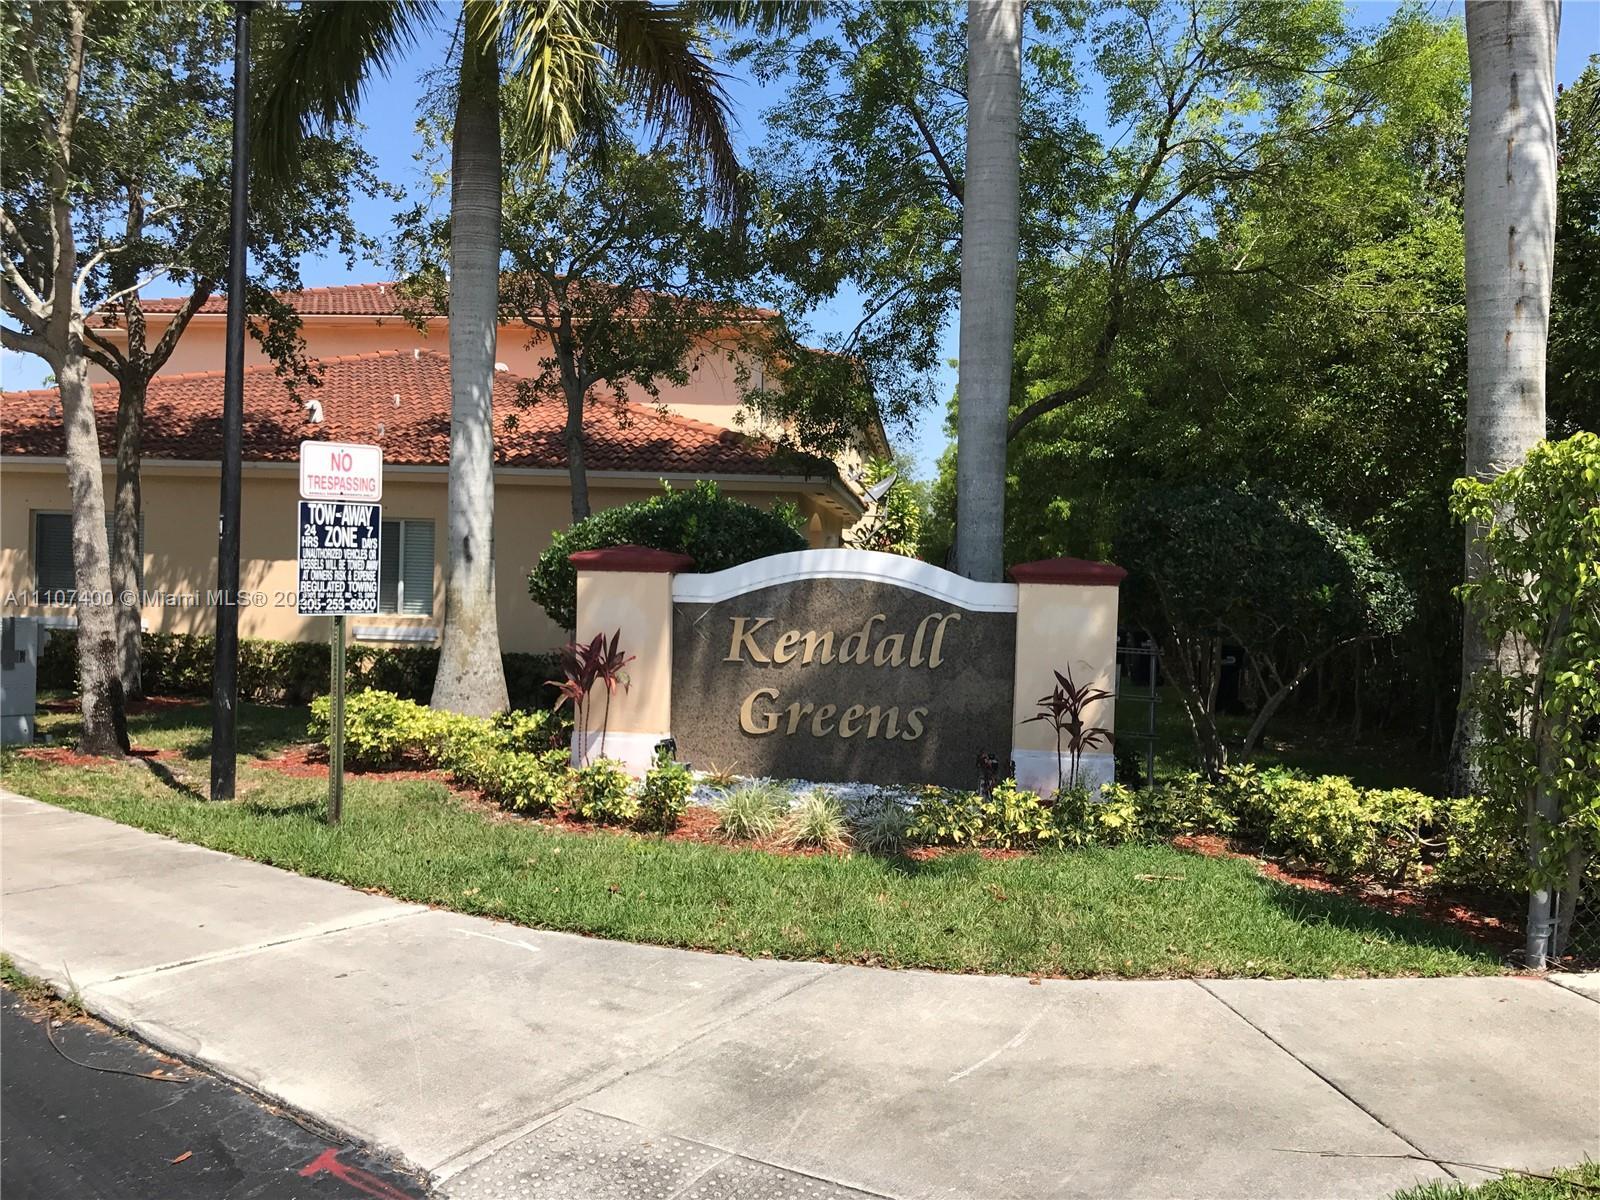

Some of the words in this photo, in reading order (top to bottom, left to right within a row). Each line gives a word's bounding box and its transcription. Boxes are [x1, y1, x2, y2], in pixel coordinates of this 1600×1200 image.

[331, 452, 353, 472] NO
[307, 474, 376, 492] TRESPASSING
[307, 503, 373, 526] TOW-AWAY
[304, 524, 317, 536] 24
[366, 527, 374, 538] 7
[301, 536, 319, 548] HRS
[324, 526, 358, 548] ZONE
[361, 538, 378, 549] DAYS
[302, 548, 343, 559] UNAUTHORIZED
[343, 549, 368, 560] VEHICLES
[368, 550, 377, 560] OR
[300, 559, 325, 570] VESSELS
[325, 559, 338, 570] WILL
[338, 560, 346, 570] BE
[347, 560, 365, 571] TOWED
[302, 569, 310, 581] AT
[334, 571, 347, 581] RISK
[353, 571, 377, 581] EXPENSE
[300, 580, 346, 593] REGULATED
[347, 581, 377, 593] TOWING
[299, 598, 377, 610] 305-253-6900
[722, 612, 962, 670] Kendall
[738, 687, 929, 741] Greens
